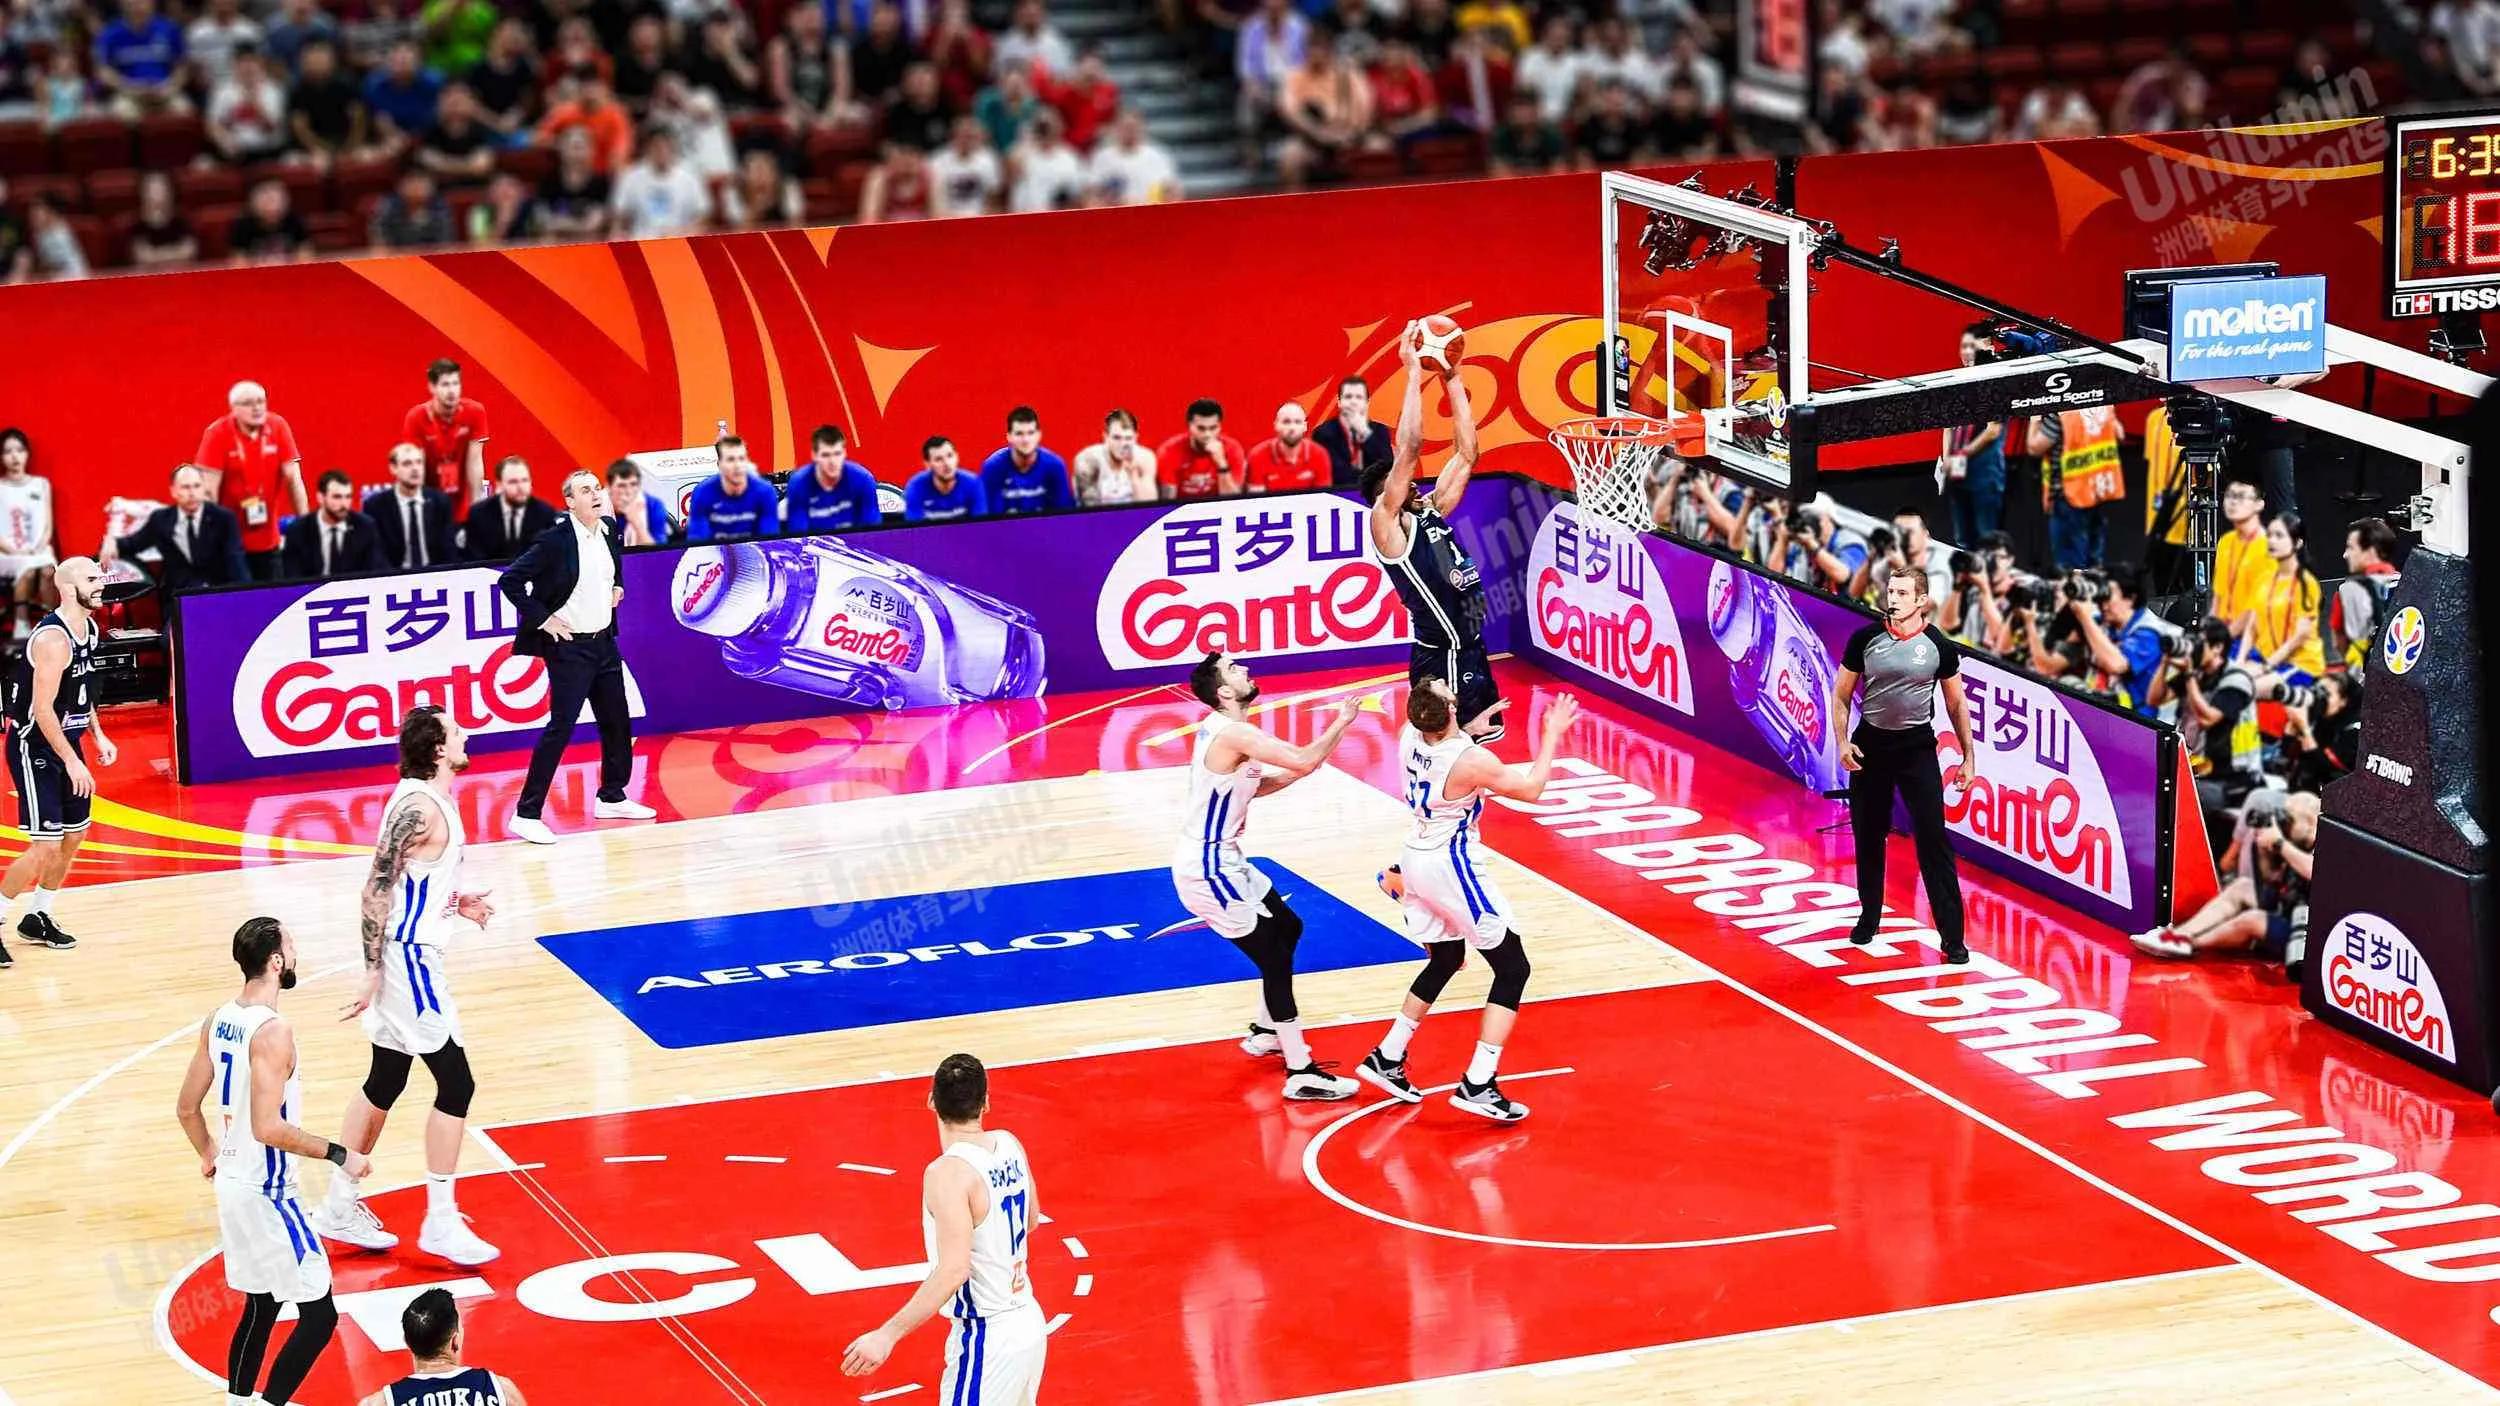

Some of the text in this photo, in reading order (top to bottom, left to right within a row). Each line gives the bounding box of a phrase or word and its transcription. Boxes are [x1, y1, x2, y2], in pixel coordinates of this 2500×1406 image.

[2432, 134, 2500, 179] 6:3
[2183, 299, 2313, 339] molten
[2432, 287, 2500, 313] TISS
[2179, 338, 2314, 361] For the real game
[2062, 388, 2105, 402] Sports
[1162, 507, 1365, 577] 百岁山
[1553, 512, 1644, 601] 百岁山
[305, 584, 520, 659] 百岁山
[823, 612, 910, 665] Ganten
[1537, 566, 1679, 704] Ganten
[261, 641, 551, 747] Gante
[1777, 668, 1820, 743] Ganten
[636, 923, 1141, 995] AEROFLOT
[2345, 921, 2418, 987] 百岁山
[2329, 954, 2444, 1054] Ganten
[220, 1051, 233, 1106] 7
[1592, 833, 2207, 1100] BASKETBALL
[2106, 1090, 2500, 1283] WORLD
[1001, 1189, 1026, 1256] 17
[275, 1232, 935, 1353] TCL
[402, 1387, 499, 1406] LOUKAS
